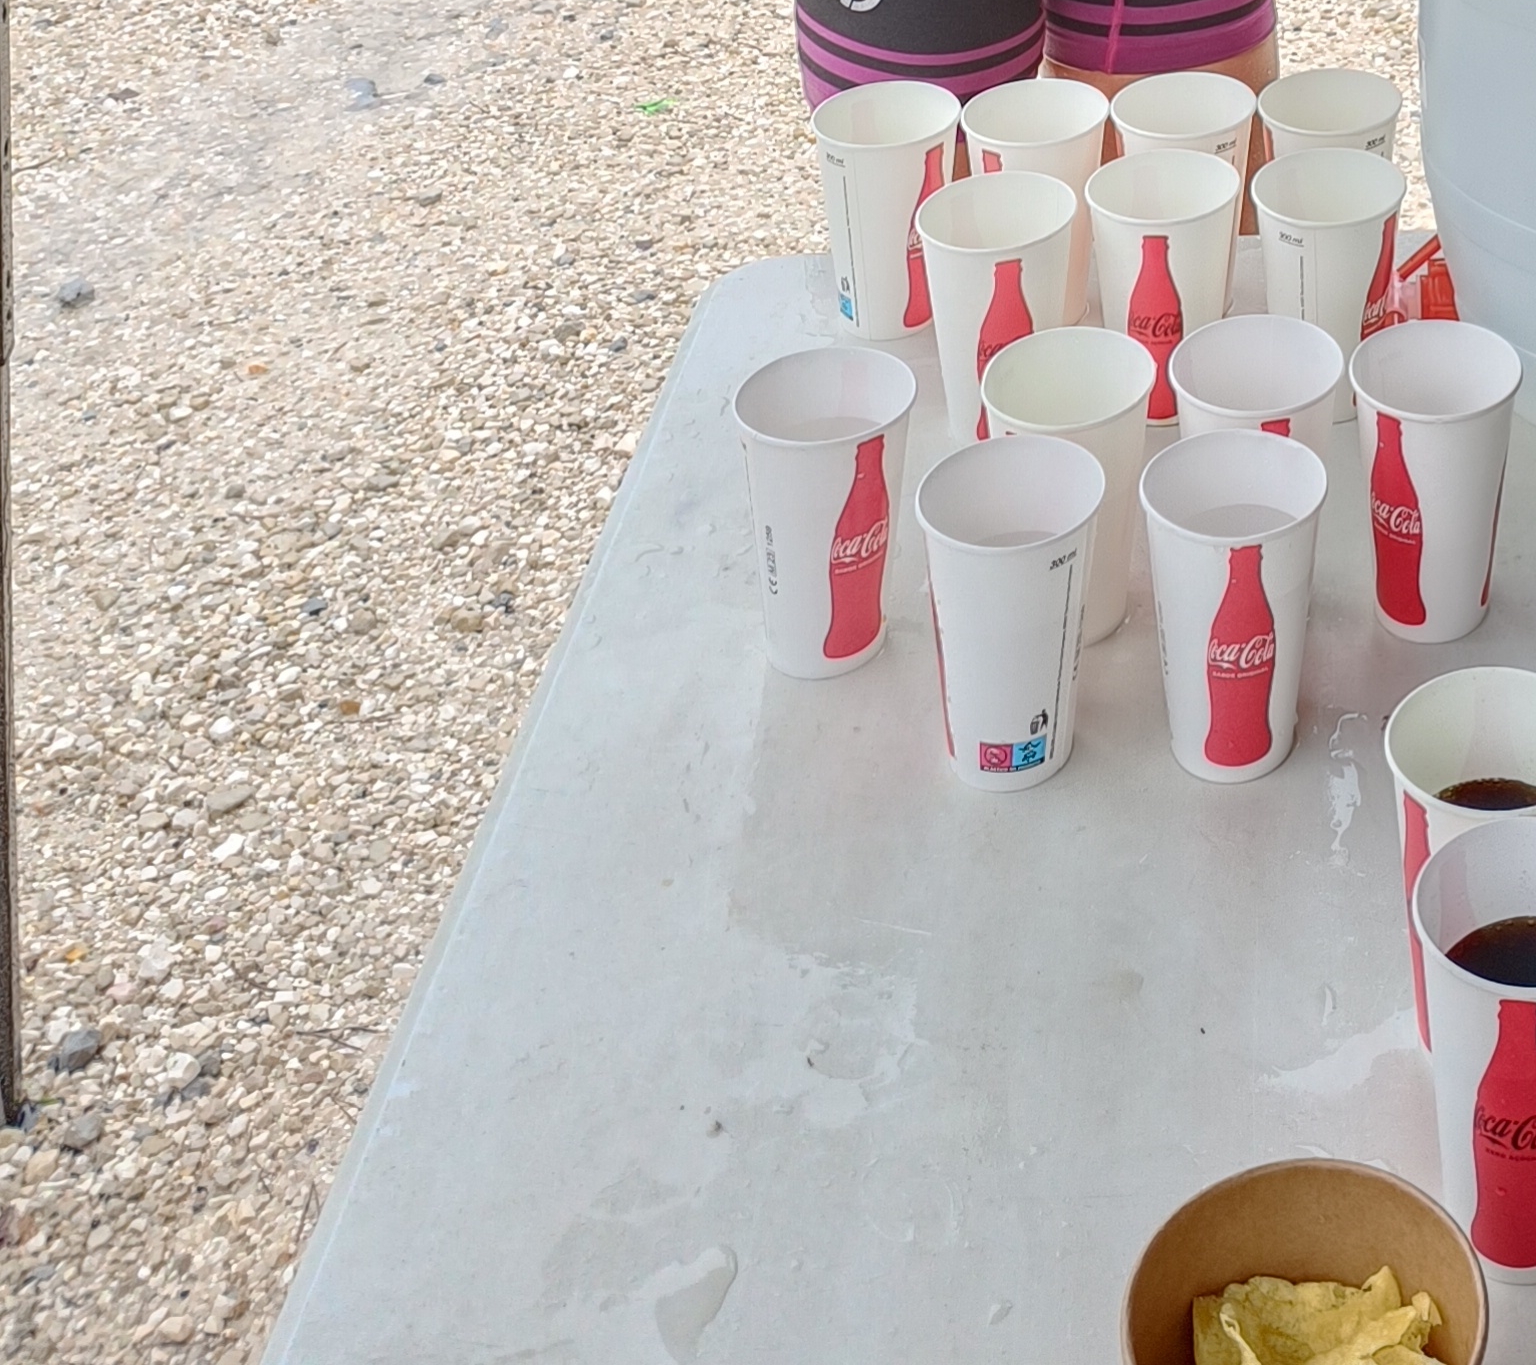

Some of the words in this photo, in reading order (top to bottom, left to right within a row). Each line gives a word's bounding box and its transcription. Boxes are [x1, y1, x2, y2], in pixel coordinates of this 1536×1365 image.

[1131, 311, 1180, 338] ca-Cola
[1049, 554, 1067, 570] 300
[1067, 547, 1078, 562] ml
[1209, 631, 1275, 670] Coca-Cola
